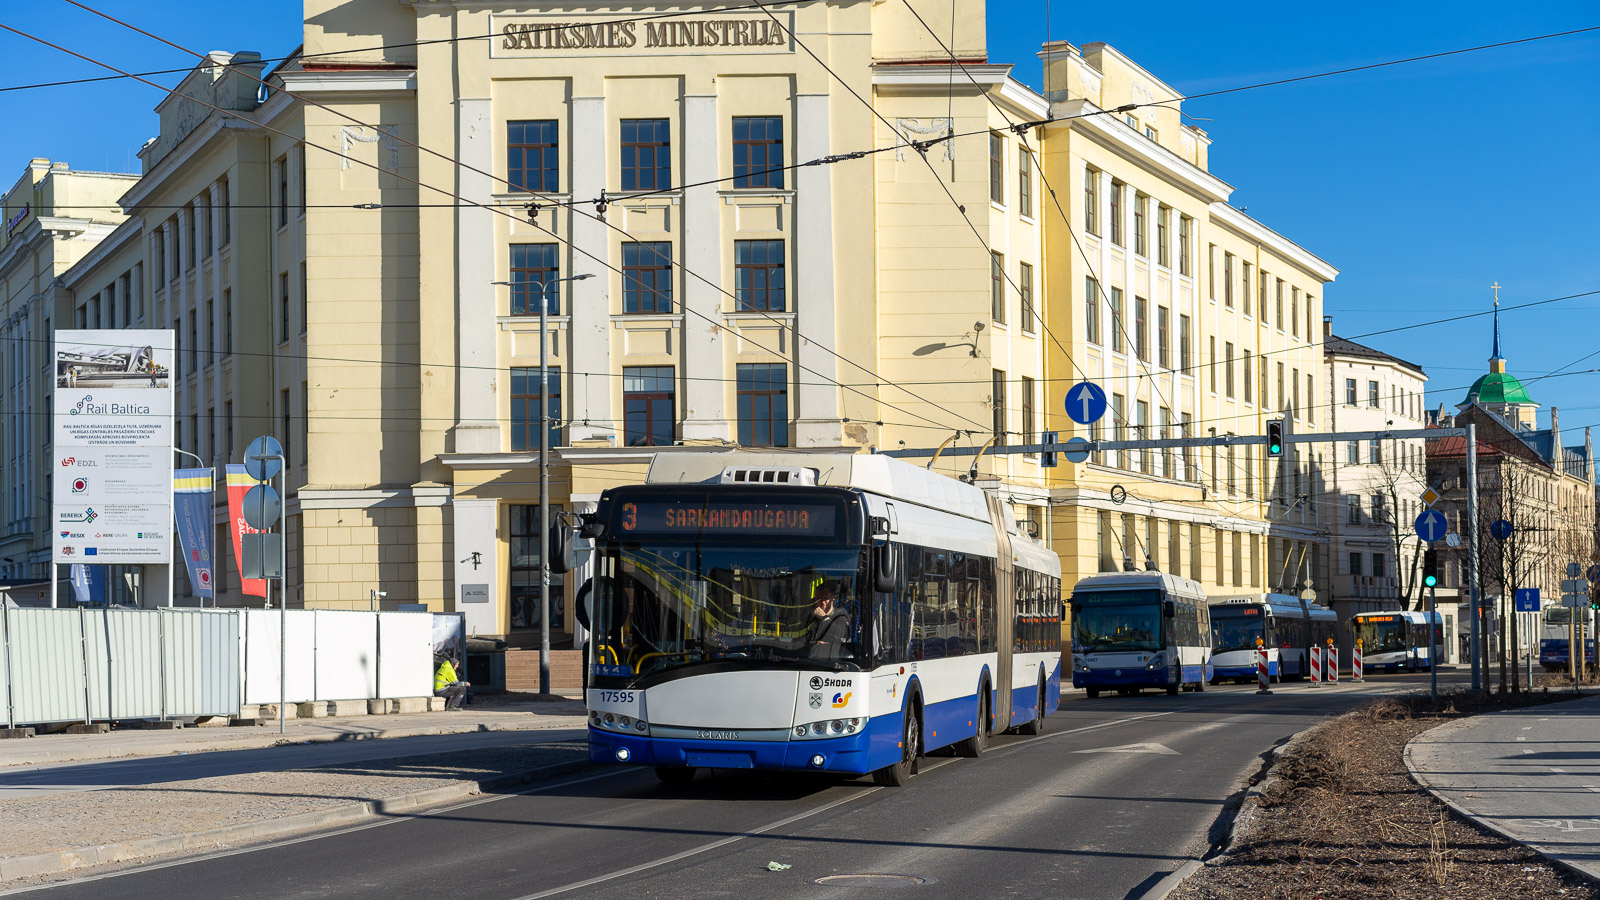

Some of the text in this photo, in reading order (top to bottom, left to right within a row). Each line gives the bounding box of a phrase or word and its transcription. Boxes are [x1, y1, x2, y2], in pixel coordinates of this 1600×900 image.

[503, 19, 786, 49] SATIKSMES MINISTRIJA
[86, 403, 150, 414] Rail Baltica
[622, 502, 810, 530] 3 SARKANDAUGAVA
[824, 678, 852, 687] ŠKODA
[600, 691, 634, 703] 17595
[696, 730, 739, 740] SOLARIS
